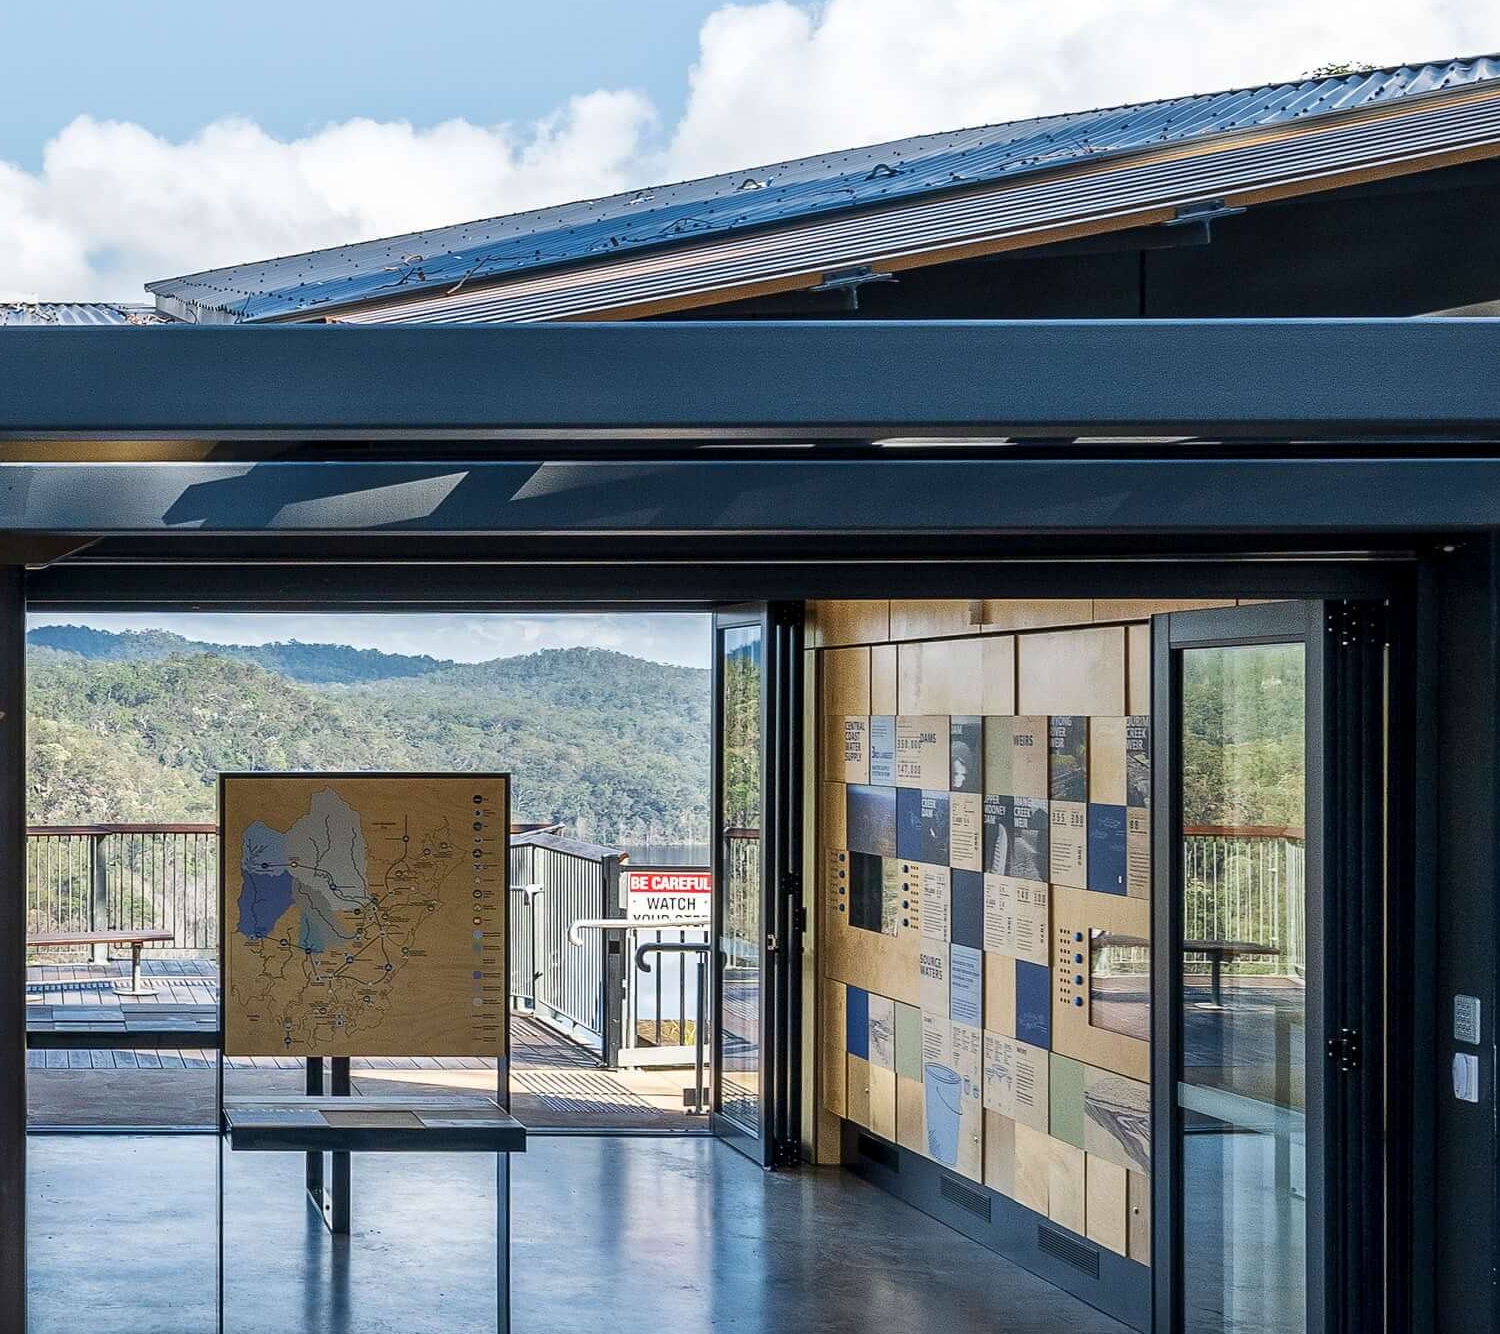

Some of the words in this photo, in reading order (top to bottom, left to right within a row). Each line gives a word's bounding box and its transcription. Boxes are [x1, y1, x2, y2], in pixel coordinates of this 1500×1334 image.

[1014, 735, 1033, 746] WEIRS
[631, 876, 649, 890] BE
[652, 876, 711, 891] CAREFUL
[647, 897, 696, 911] WATCH
[920, 954, 942, 969] SOURCE
[920, 967, 943, 980] WATERS
